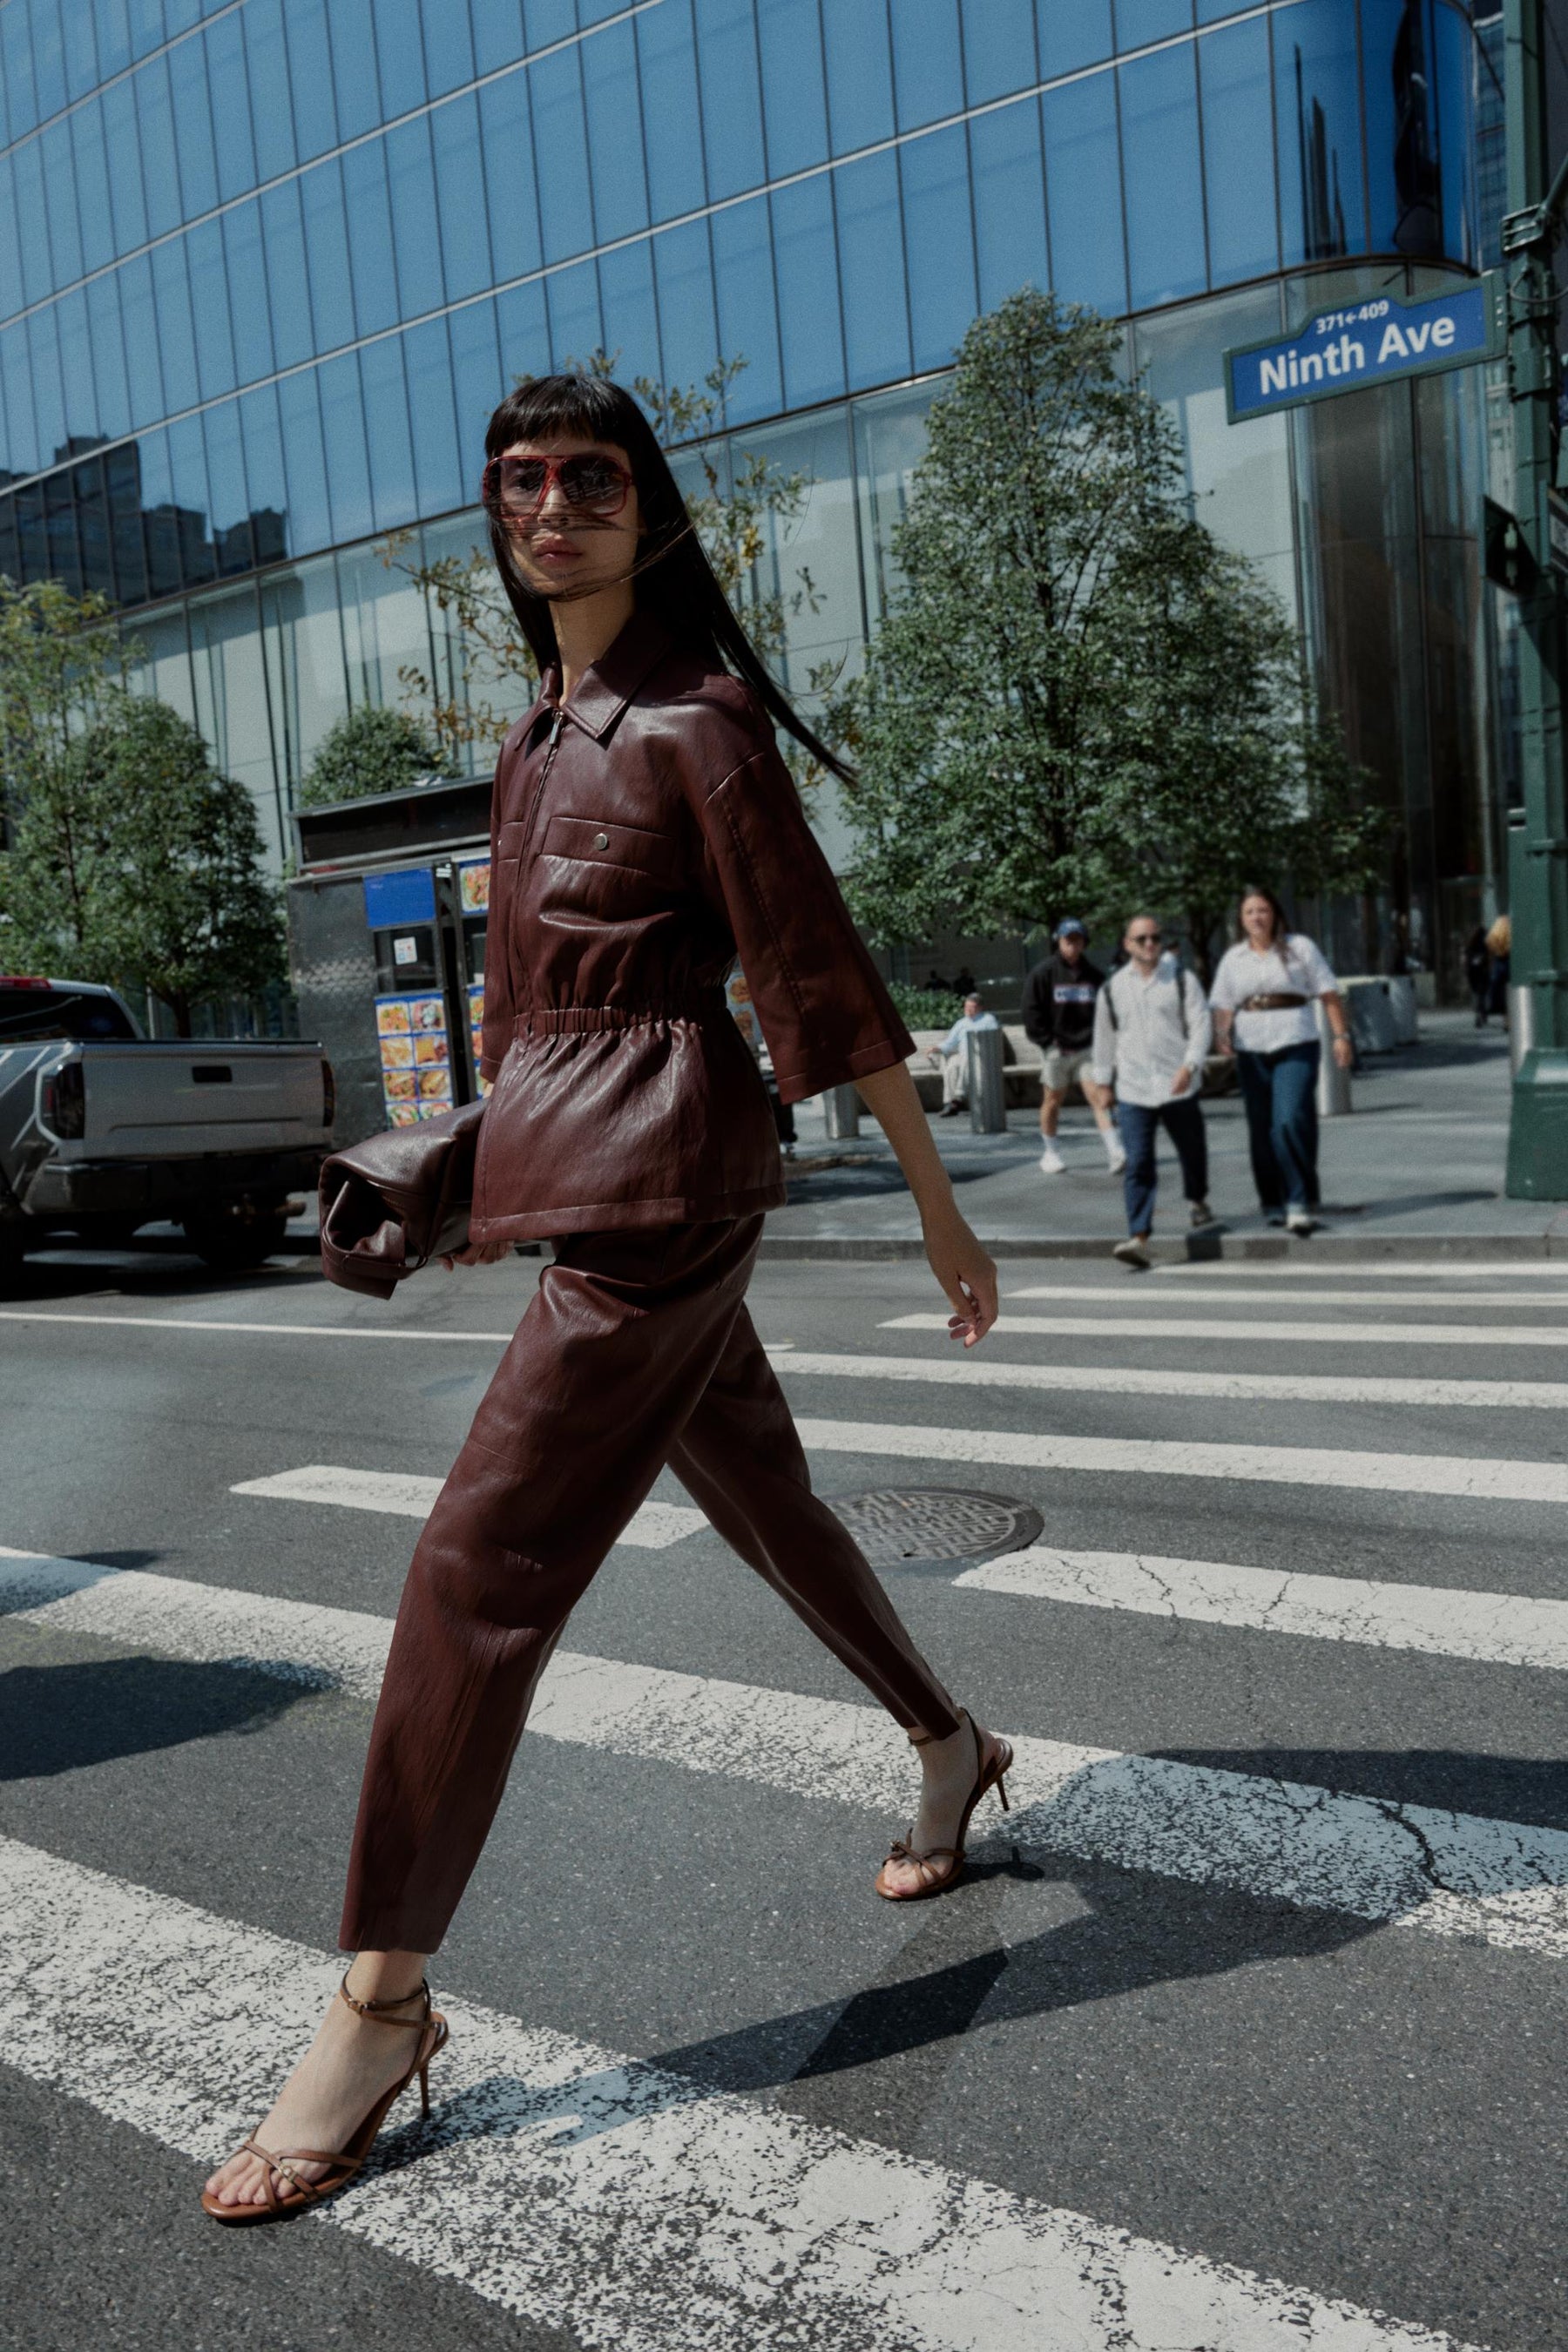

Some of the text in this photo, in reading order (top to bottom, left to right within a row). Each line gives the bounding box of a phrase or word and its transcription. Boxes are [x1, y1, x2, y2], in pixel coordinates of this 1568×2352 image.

[1316, 300, 1389, 335] 371 409
[1259, 316, 1456, 395] Ninth Ave
